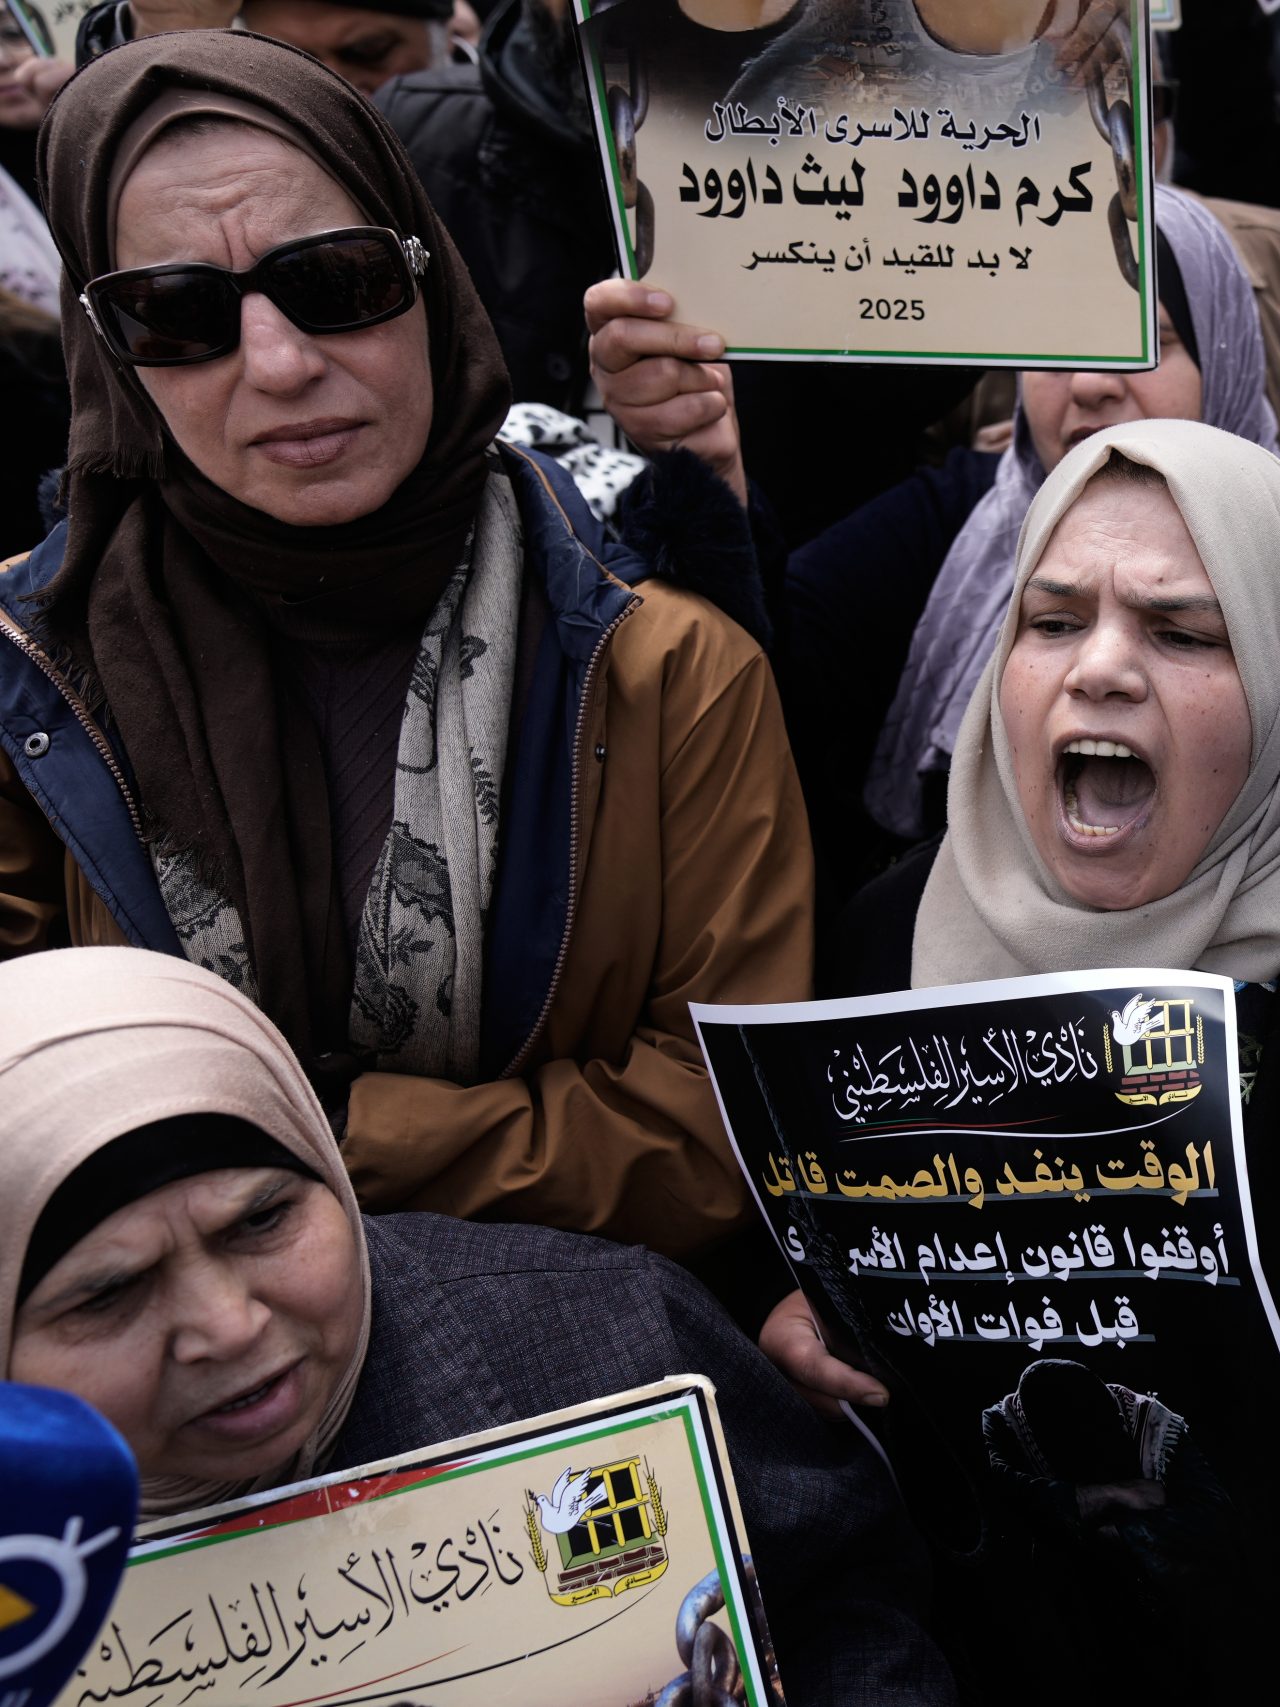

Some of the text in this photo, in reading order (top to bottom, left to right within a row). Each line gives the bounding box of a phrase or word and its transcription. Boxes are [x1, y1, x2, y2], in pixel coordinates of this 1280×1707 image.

[704, 96, 817, 147] الأبطال
[939, 109, 1041, 149] الحرية
[679, 153, 1094, 227] كرم داوود ليث داوود
[740, 237, 1032, 277] لا بد للقيد أن ينكسر
[859, 299, 925, 321] 2025
[762, 1139, 1215, 1209] الوقت ينفد والصمت قاتل
[918, 1231, 1014, 1286] إعدام
[1021, 1223, 1115, 1283] قانون
[1122, 1222, 1229, 1286] أوقفوا
[886, 1293, 1139, 1353] قبل فوات الأوان
